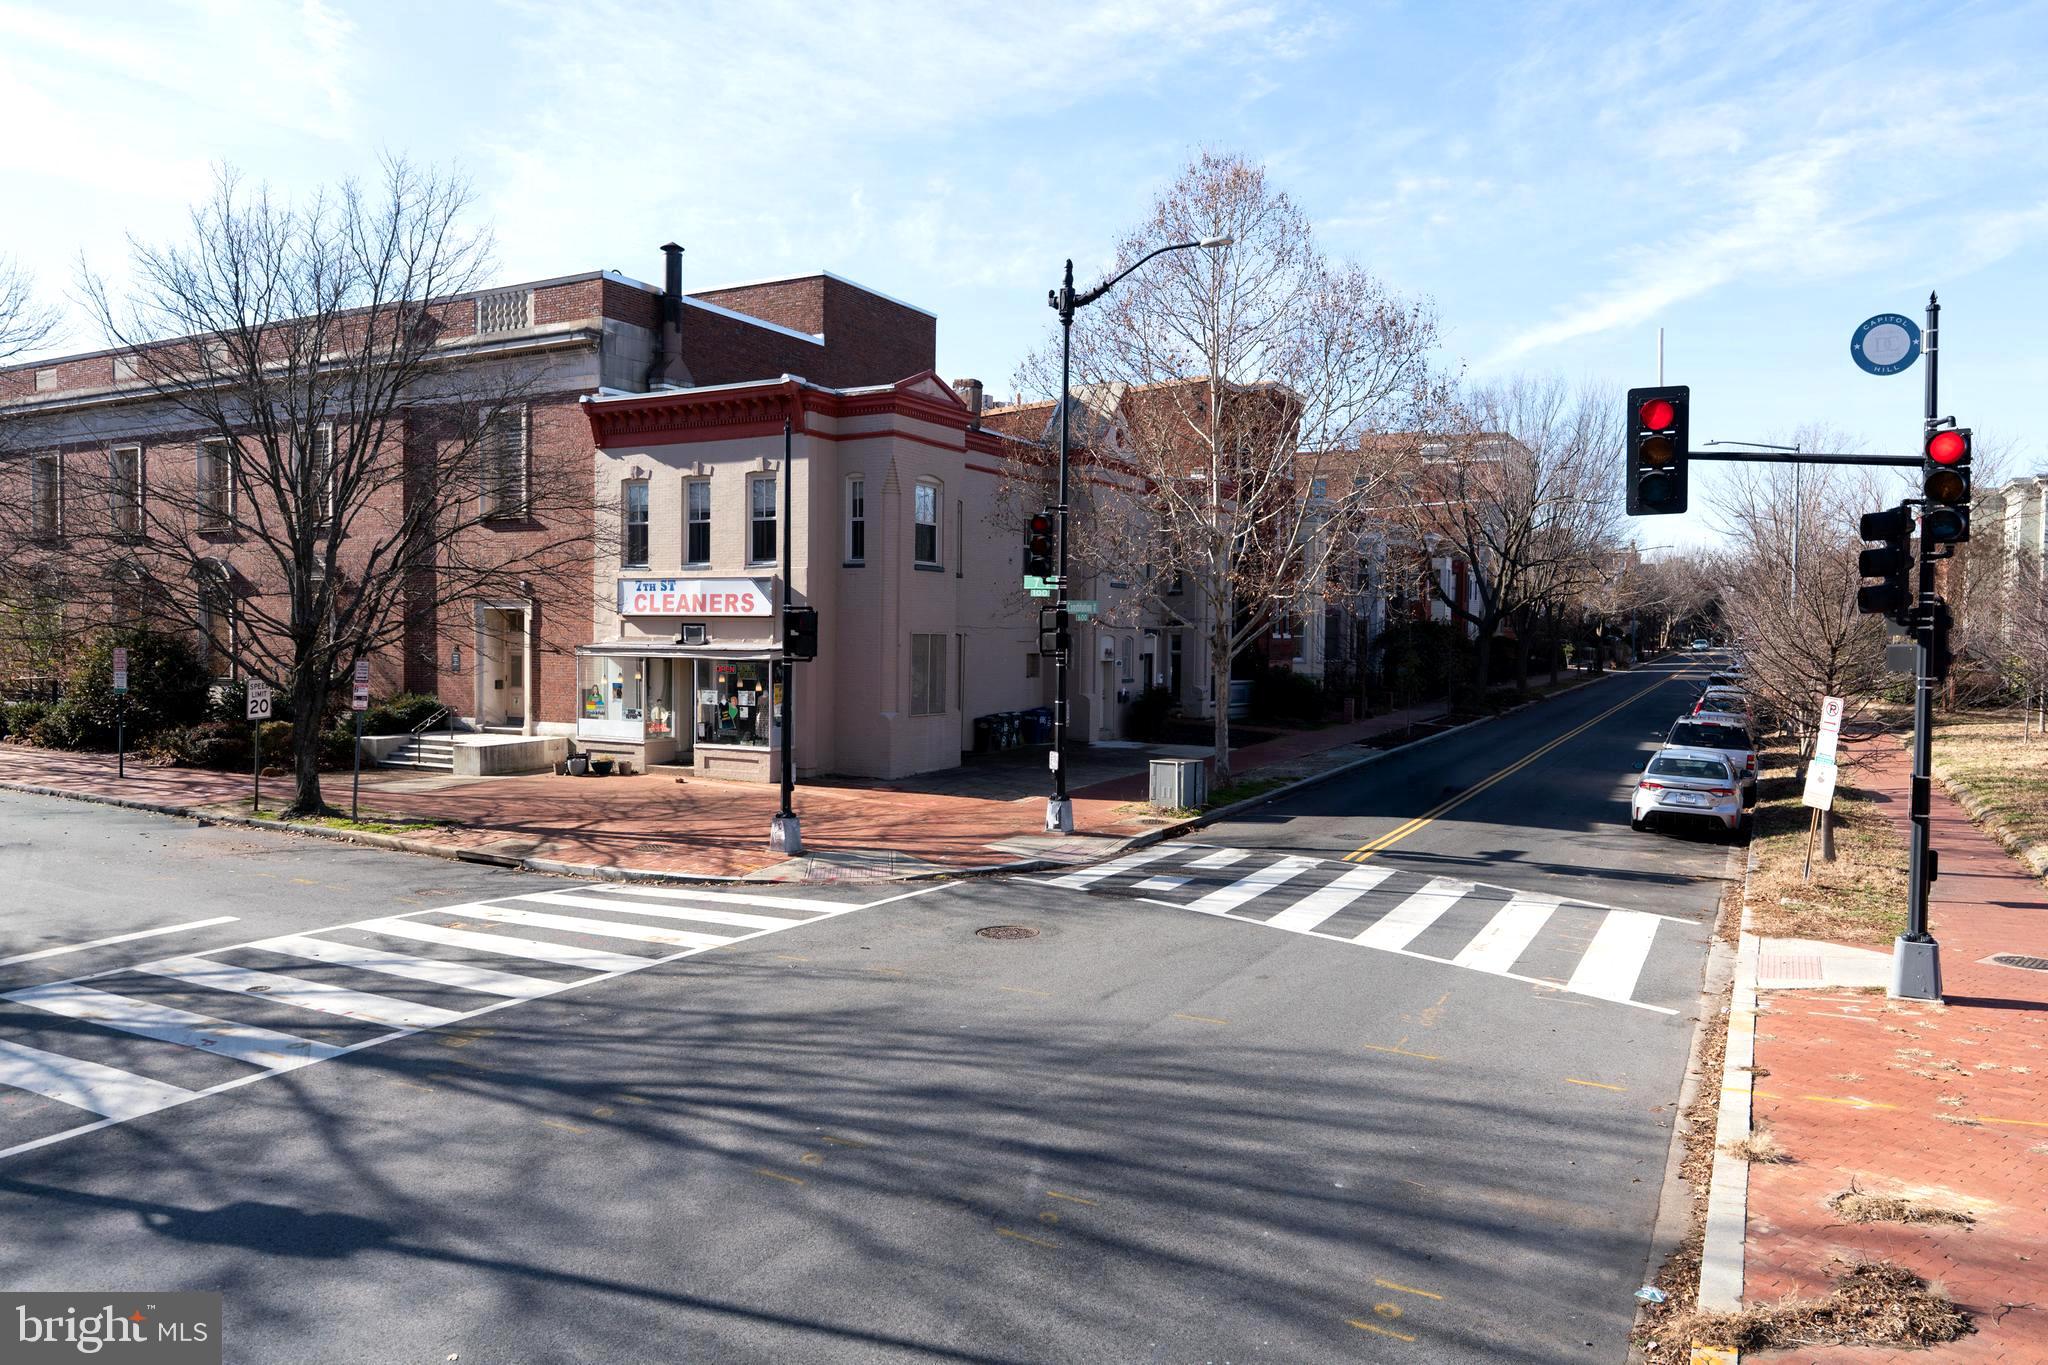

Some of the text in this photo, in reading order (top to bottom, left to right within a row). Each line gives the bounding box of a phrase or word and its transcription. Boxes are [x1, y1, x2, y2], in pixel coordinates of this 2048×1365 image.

[1863, 316, 1907, 330] CAPITOL
[1873, 365, 1900, 373] HILL
[660, 579, 676, 591] ST
[633, 593, 755, 613] CLEANERS
[250, 699, 269, 714] 20
